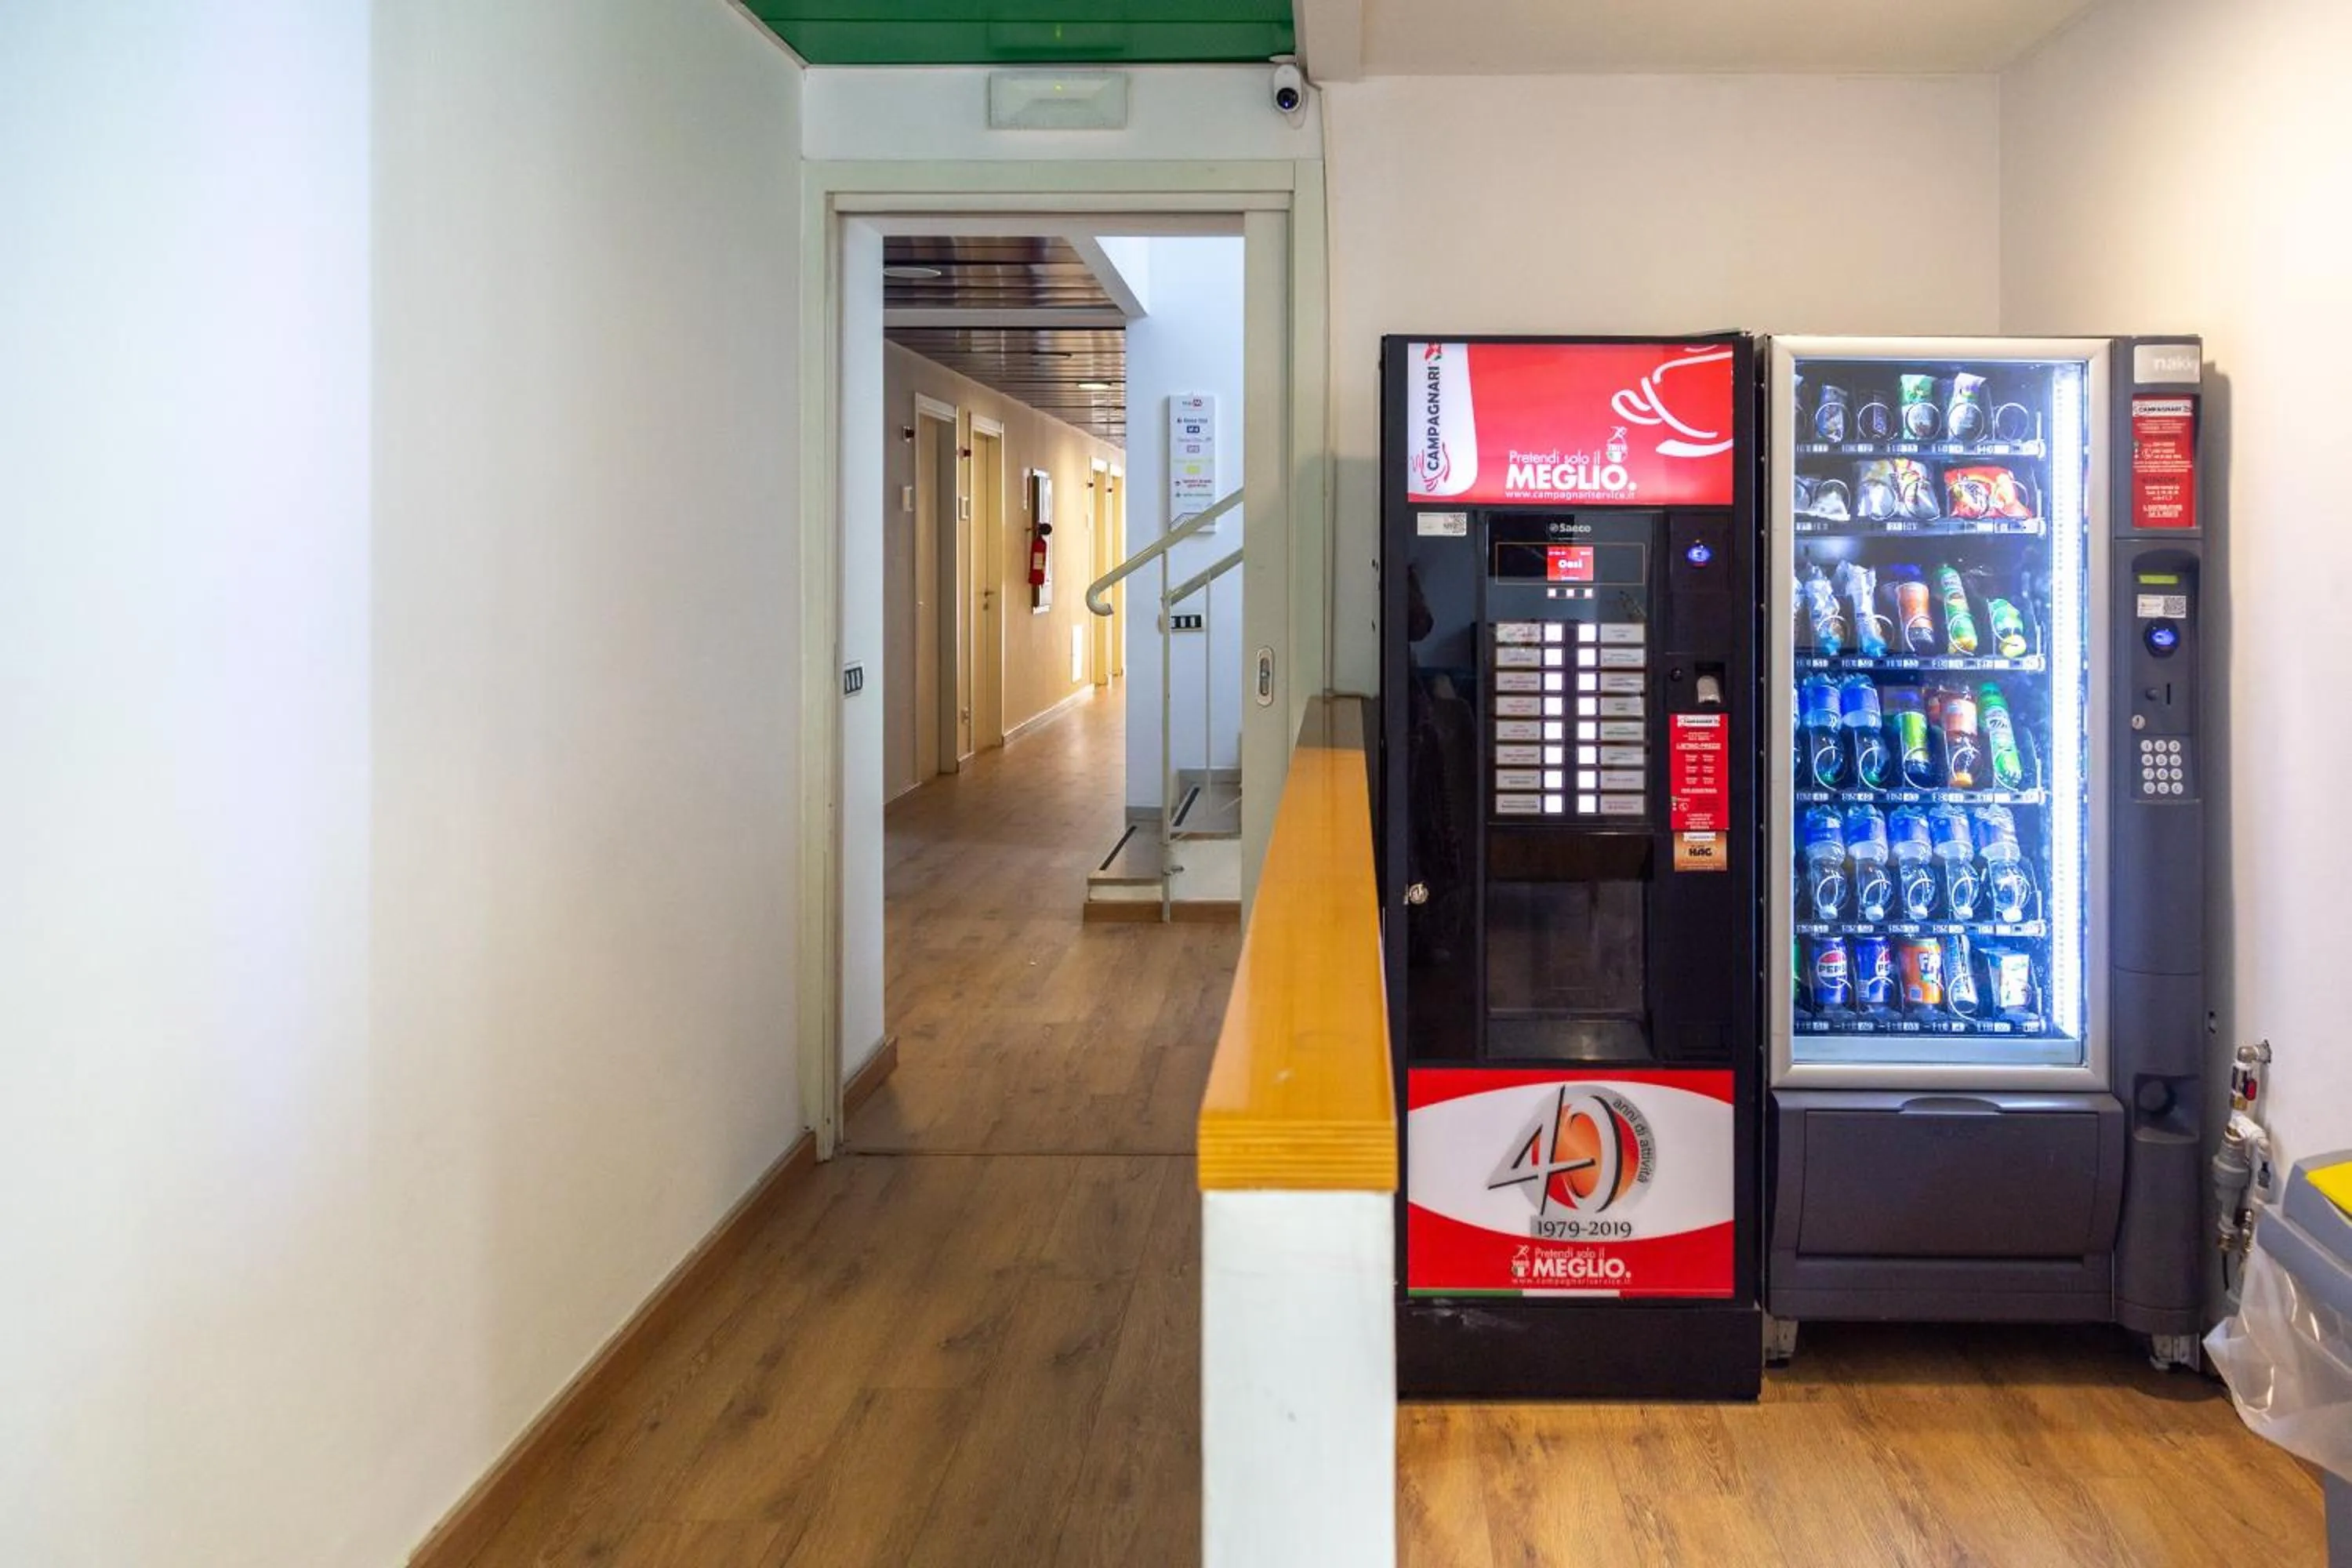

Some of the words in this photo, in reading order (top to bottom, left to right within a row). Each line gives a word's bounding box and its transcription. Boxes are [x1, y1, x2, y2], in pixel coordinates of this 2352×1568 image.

[1427, 366, 1440, 470] CAMPAGNARI
[1508, 449, 1559, 464] Pretendi
[1564, 449, 1590, 464] solo
[1594, 451, 1600, 464] il
[1505, 463, 1637, 491] MEGLIO.
[1559, 523, 1592, 532] Saeco
[1613, 1099, 1638, 1123] anni
[1634, 1123, 1647, 1136] di
[1537, 1221, 1632, 1239] 1979-2019
[1534, 1247, 1573, 1258] Pretendi
[1577, 1247, 1596, 1258] solo
[1533, 1258, 1632, 1279] MEGLIO.
